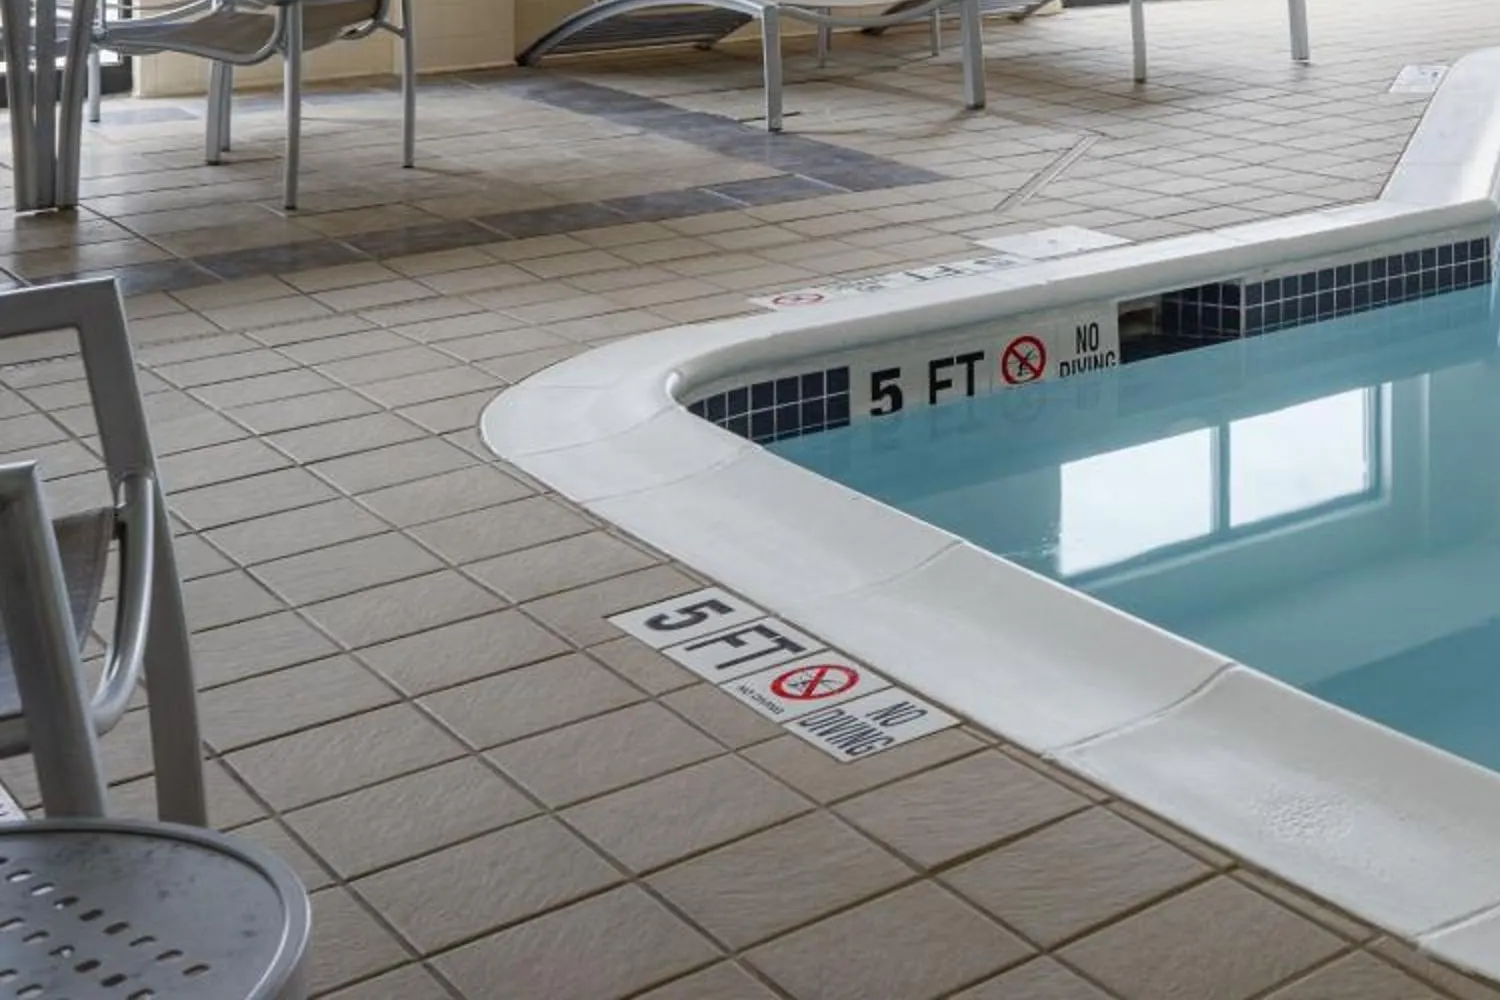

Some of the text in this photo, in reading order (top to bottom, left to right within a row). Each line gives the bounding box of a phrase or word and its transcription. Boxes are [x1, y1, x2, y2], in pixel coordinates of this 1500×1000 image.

[1076, 322, 1099, 354] NO
[870, 350, 985, 416] 5 FT
[644, 599, 806, 670] 5 FT
[799, 708, 895, 756] DIVING
[865, 701, 928, 728] NO
